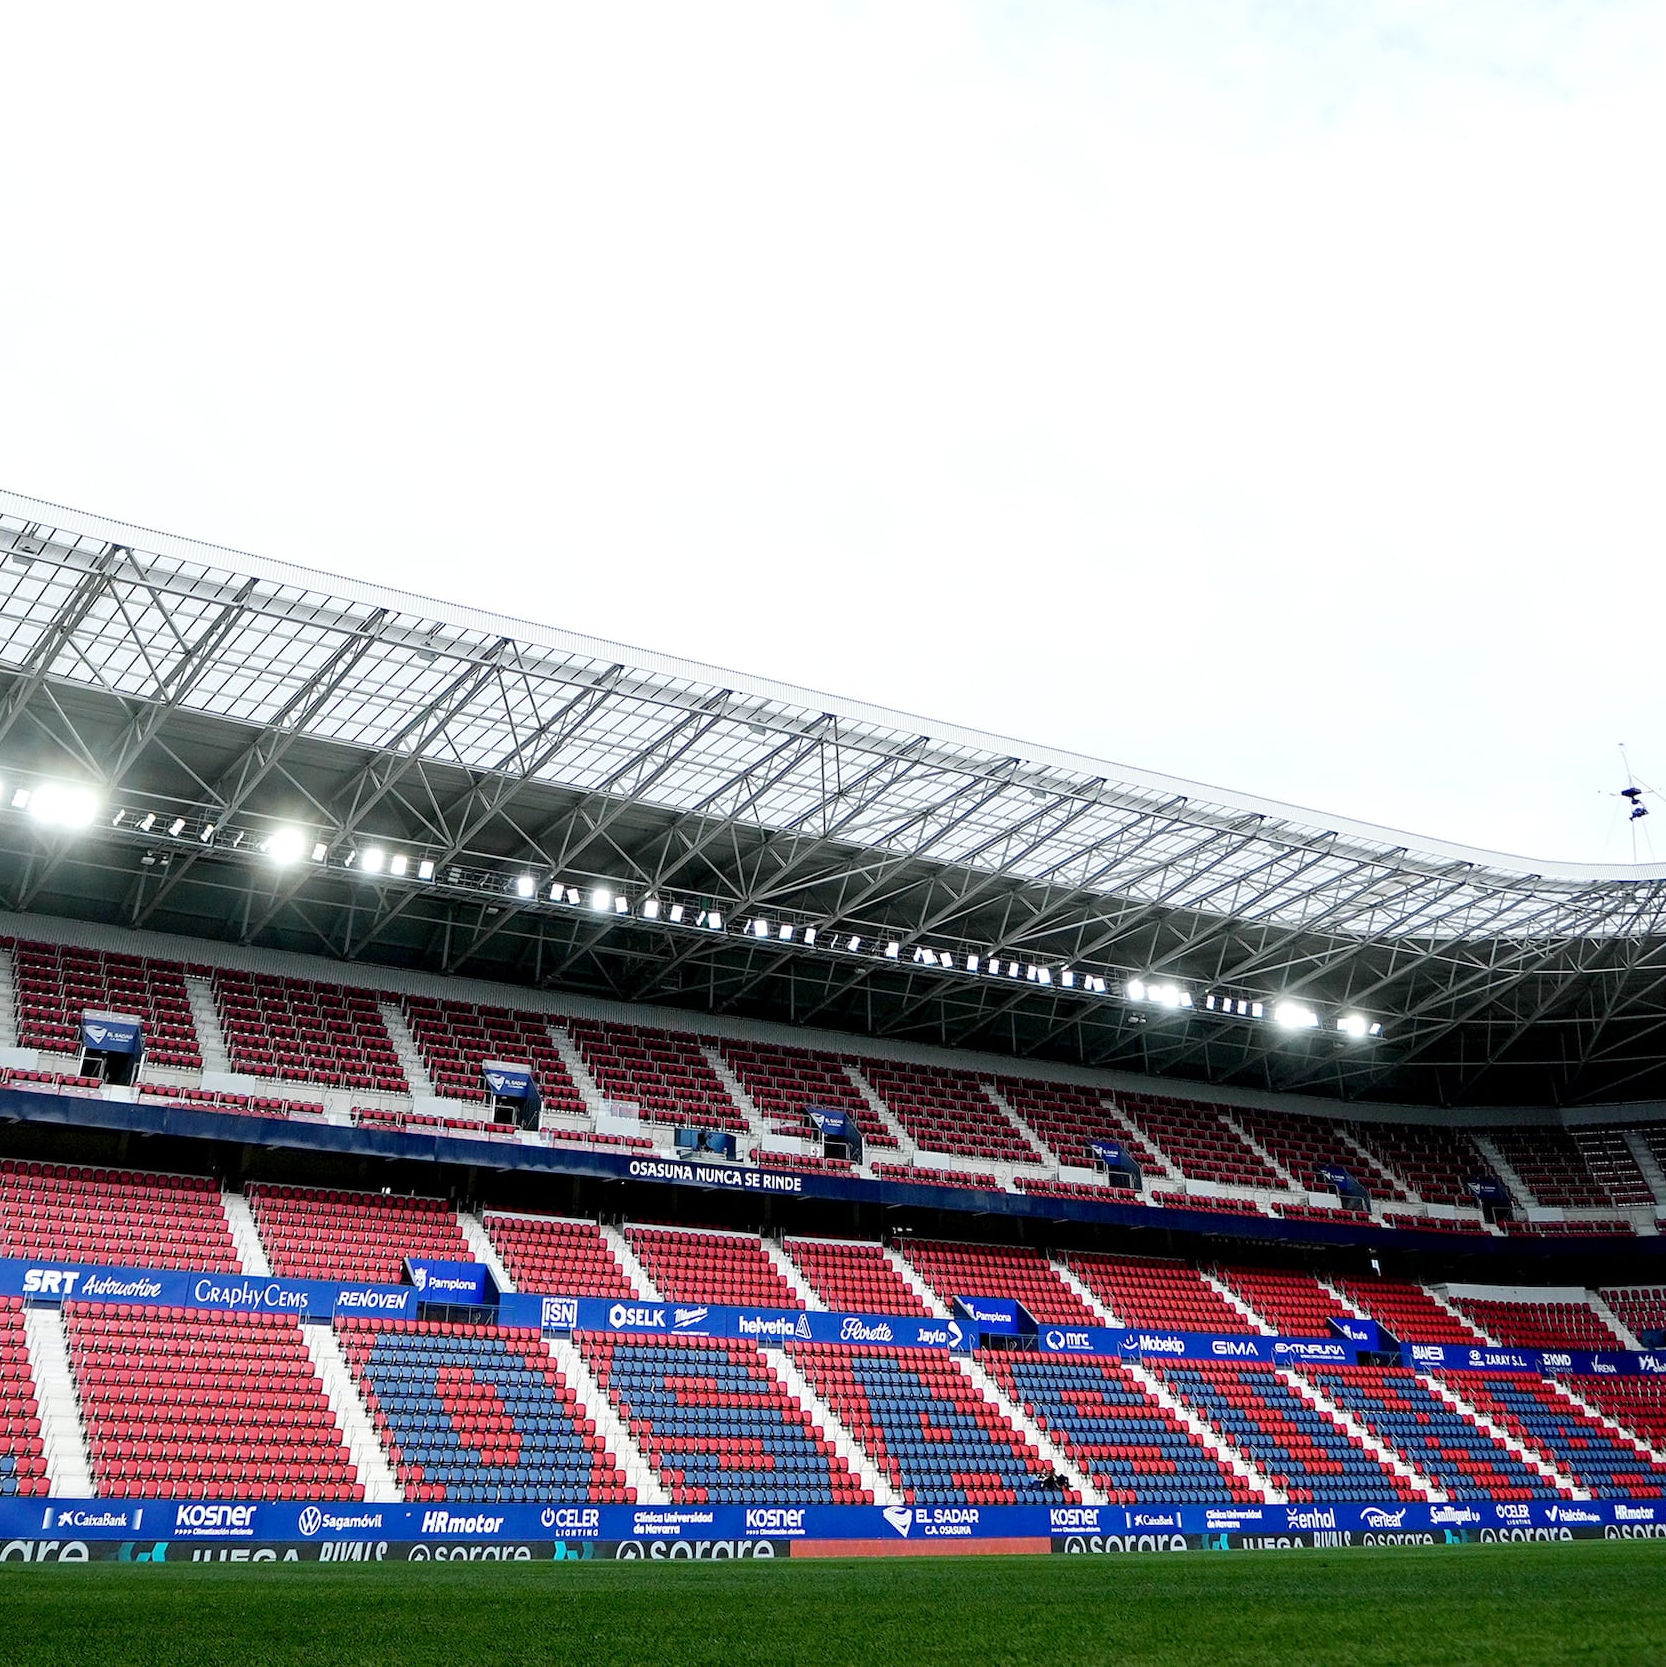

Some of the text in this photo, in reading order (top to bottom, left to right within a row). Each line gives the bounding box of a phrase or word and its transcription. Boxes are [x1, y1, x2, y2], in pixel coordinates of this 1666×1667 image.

[629, 1160, 802, 1192] OSASUNA NUNCA SE RINDE
[22, 1268, 163, 1300] SRT Automotive
[428, 1276, 477, 1293] Pamplona
[626, 1308, 666, 1327] SELK
[738, 1314, 795, 1336] helvetia
[975, 1310, 1012, 1324] Pamplona
[840, 1316, 894, 1342] Florette
[1066, 1332, 1090, 1347] mrc
[1139, 1334, 1185, 1356] Mobekip
[1211, 1340, 1259, 1357] GIMA
[1485, 1352, 1511, 1366] ZARAY
[73, 1510, 128, 1528] CaixaBank
[321, 1511, 383, 1531] Sagamóvil
[556, 1508, 599, 1527] CELER
[633, 1511, 713, 1525] Clínica Universidad
[915, 1508, 980, 1525] EL SADAR
[1299, 1508, 1336, 1528] enhol
[633, 1523, 681, 1535] de Navarra
[939, 1524, 972, 1536] OSASUNA
